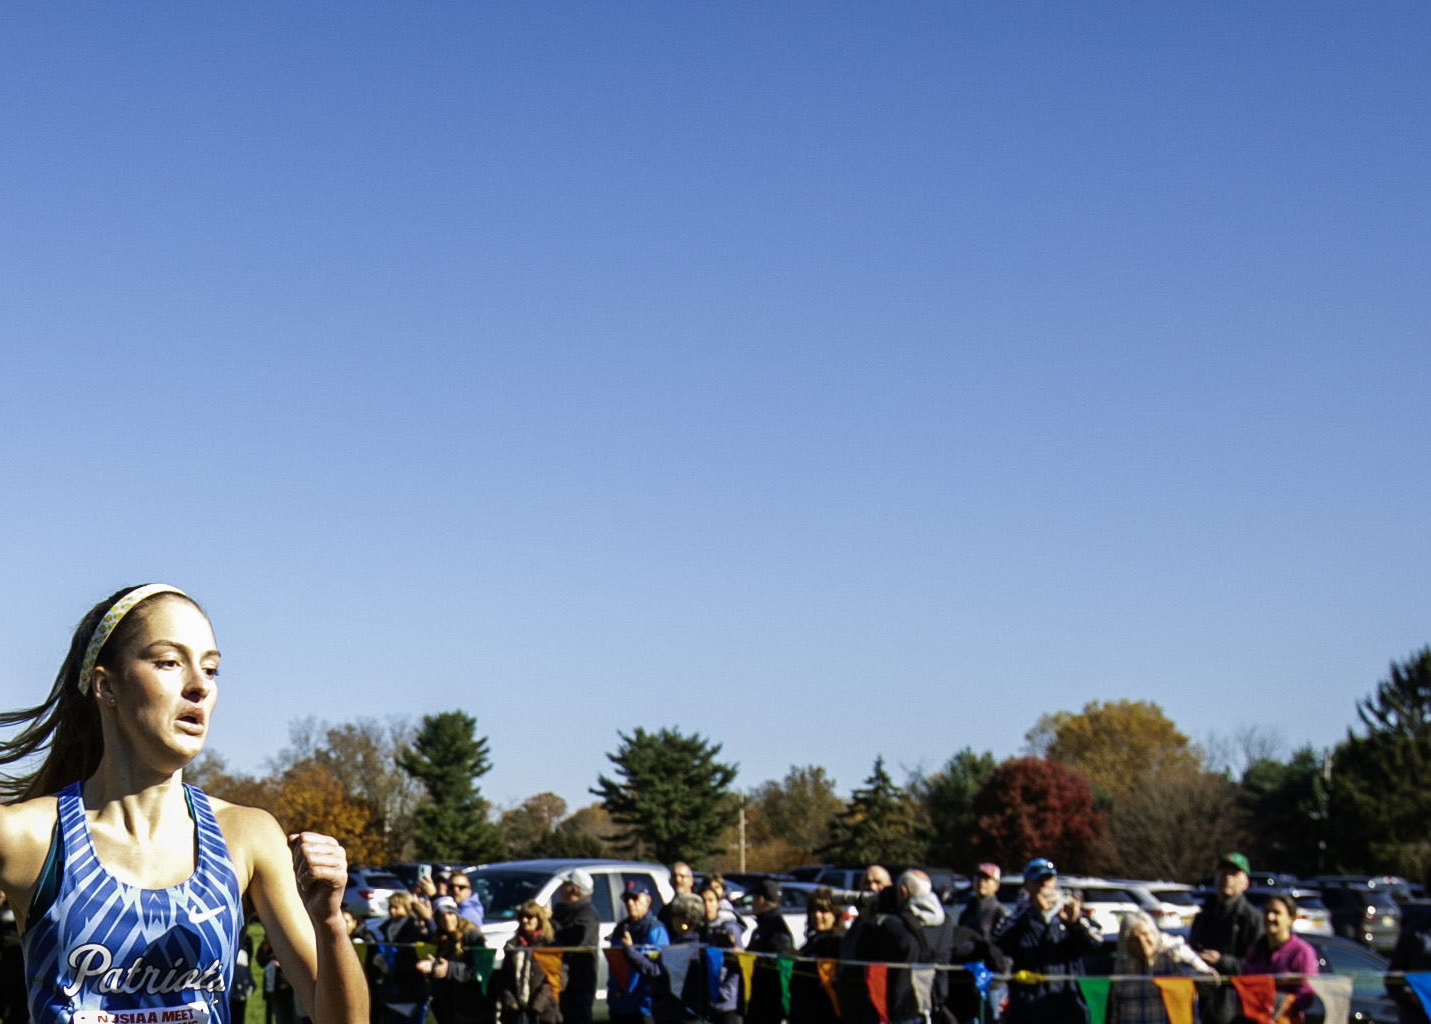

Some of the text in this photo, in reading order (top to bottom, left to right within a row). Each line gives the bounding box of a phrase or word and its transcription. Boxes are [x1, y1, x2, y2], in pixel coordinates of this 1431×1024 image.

[63, 942, 226, 997] Patriots
[97, 1008, 194, 1024] NJSIAA MEET
